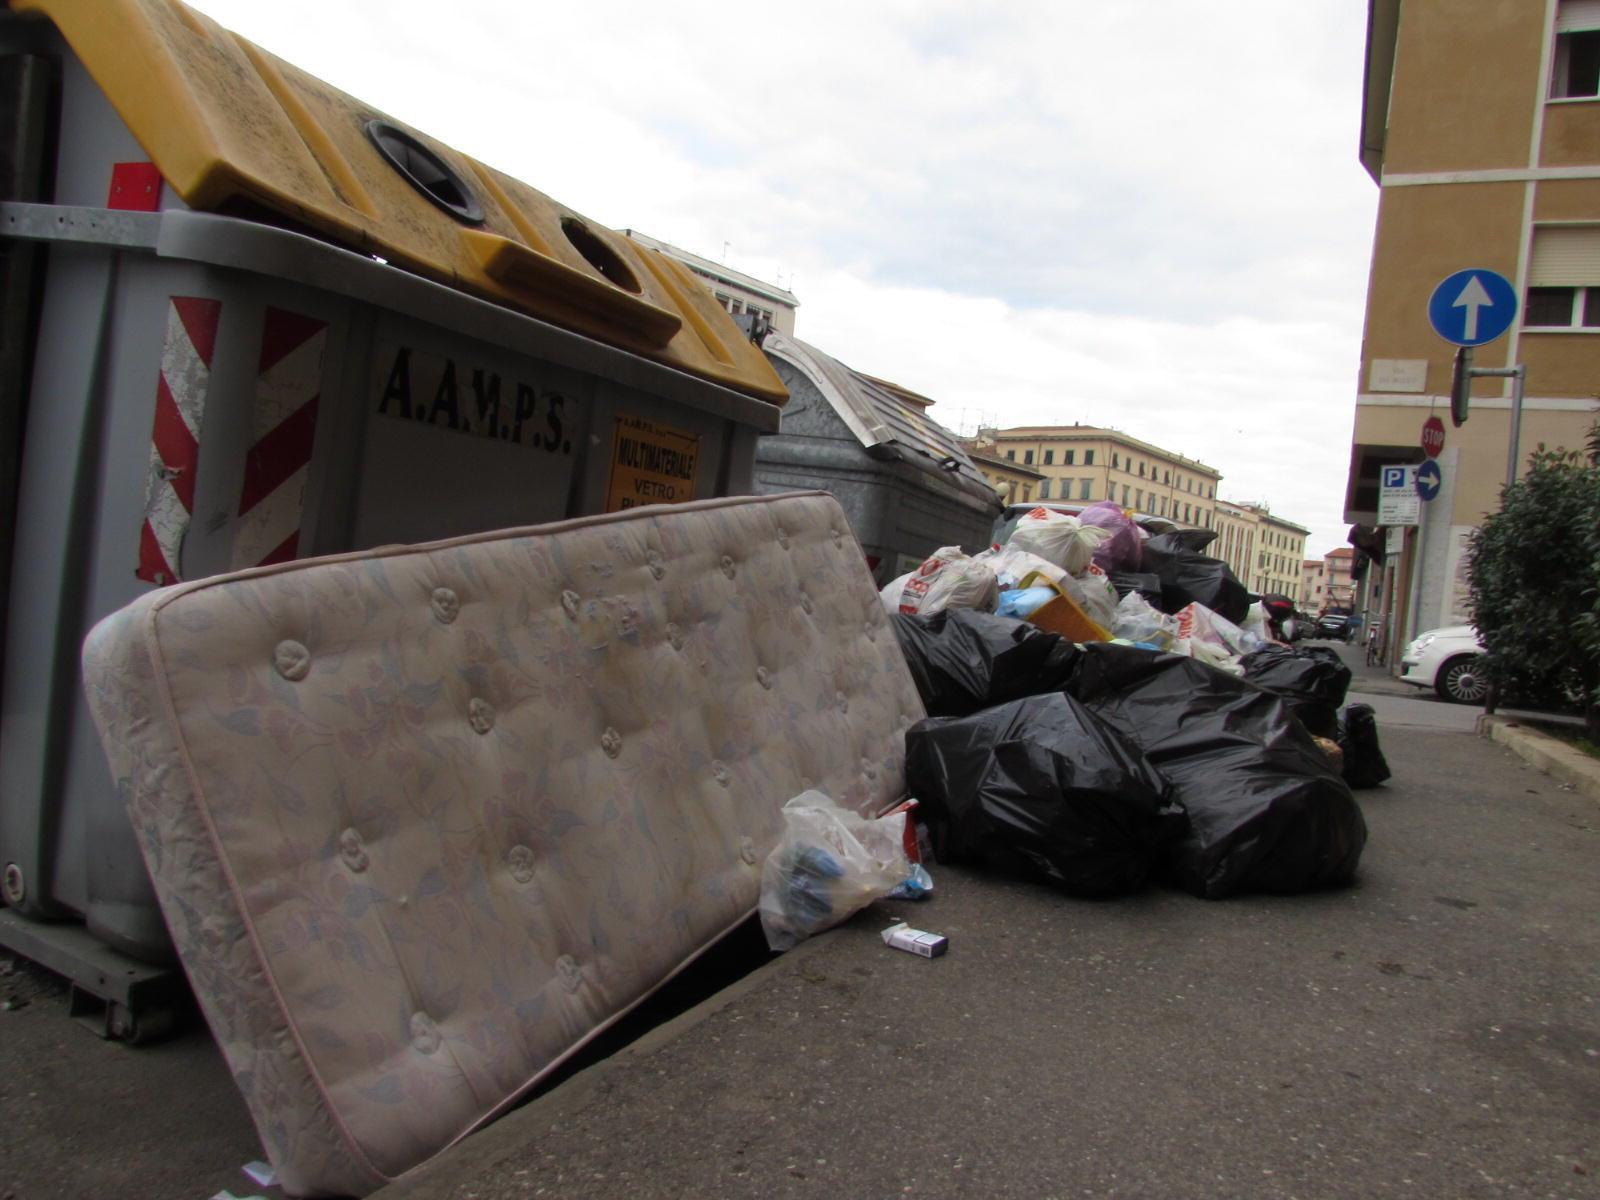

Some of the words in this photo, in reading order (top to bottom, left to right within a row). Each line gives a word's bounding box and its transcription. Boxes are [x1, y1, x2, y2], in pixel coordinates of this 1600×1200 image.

[1423, 428, 1444, 446] STOP
[618, 437, 694, 480] MULTIMATERIALE
[1387, 470, 1402, 486] P
[634, 478, 675, 500] VETRO
